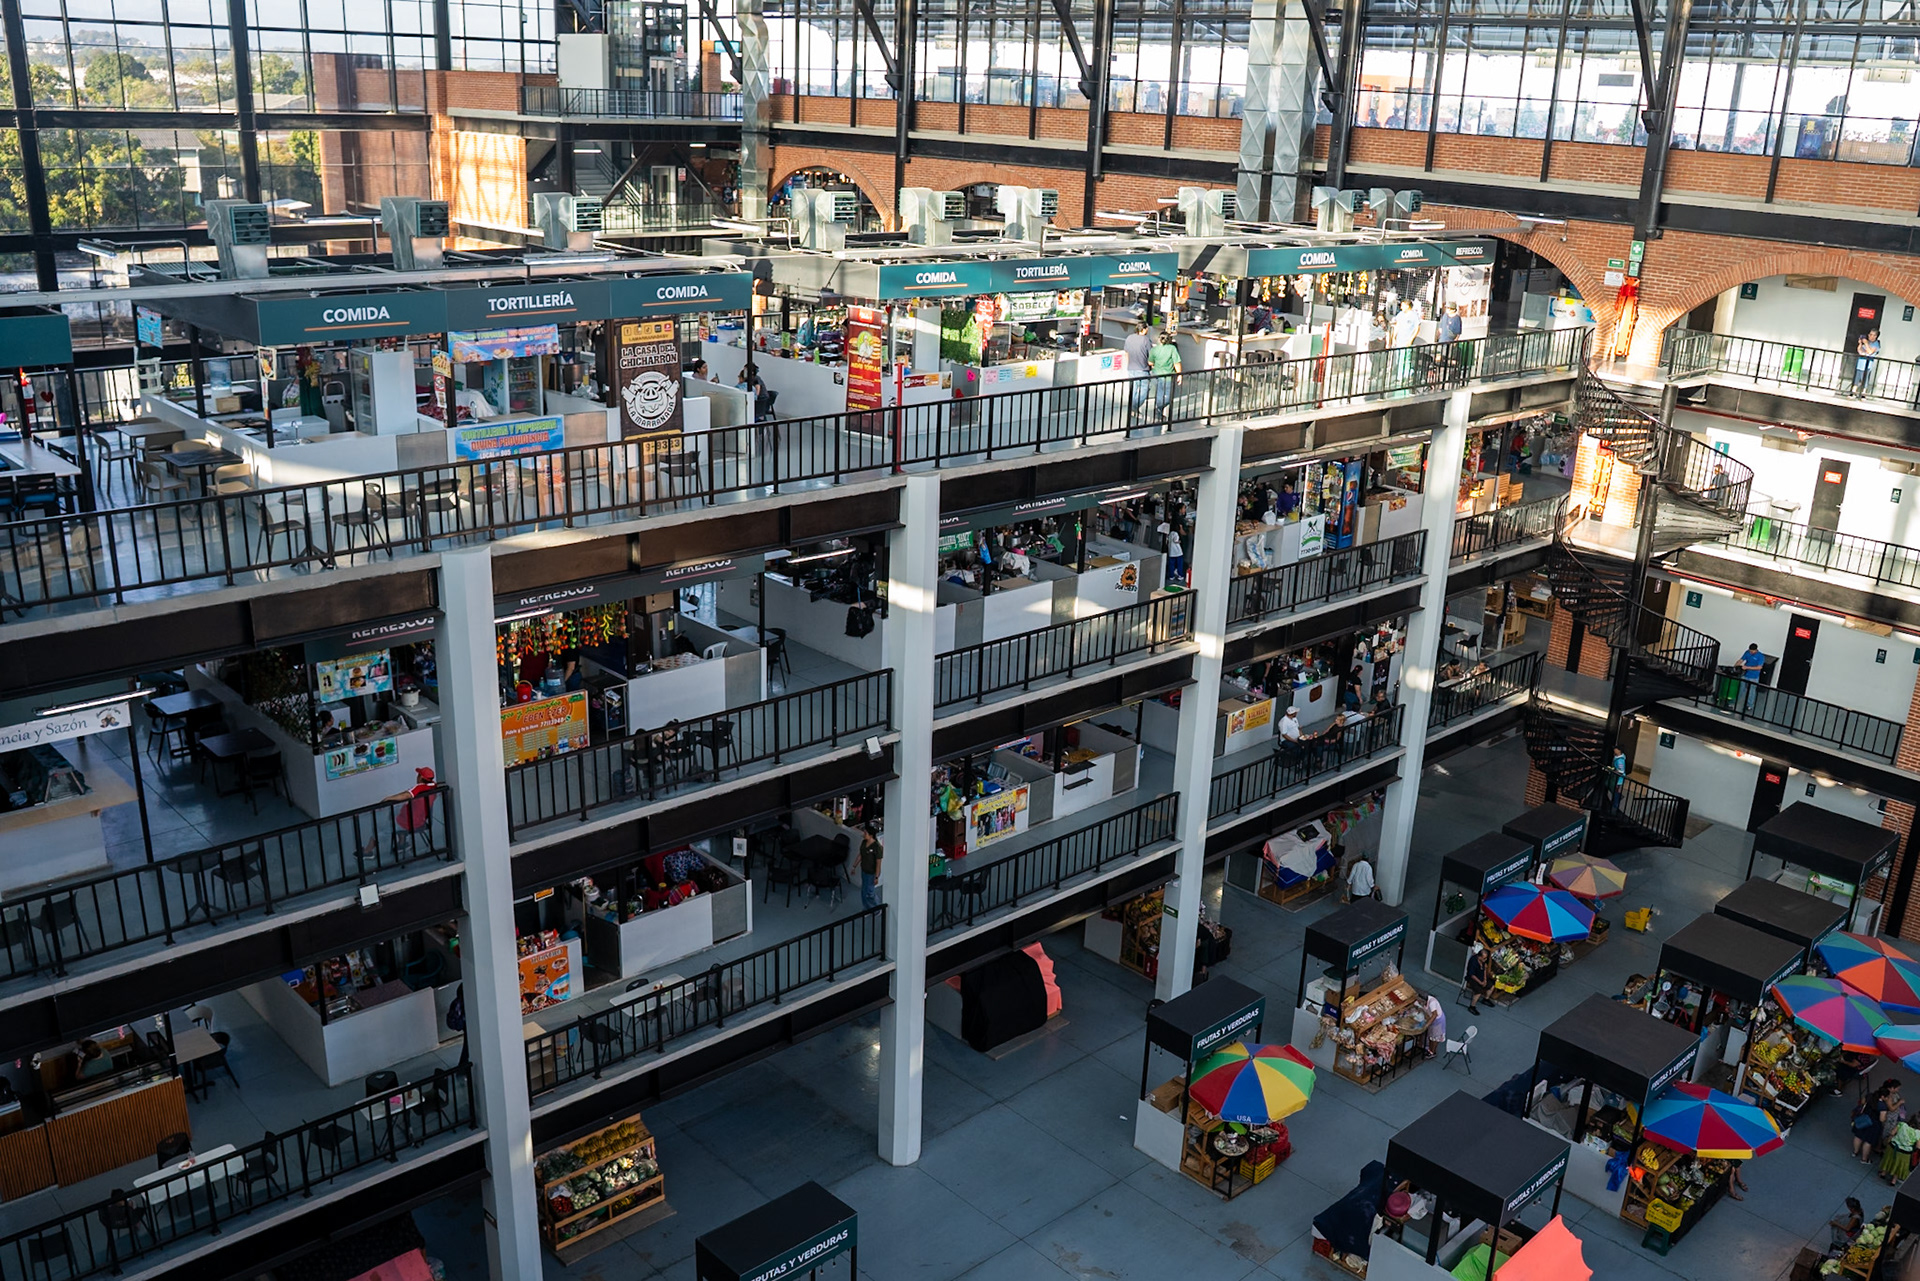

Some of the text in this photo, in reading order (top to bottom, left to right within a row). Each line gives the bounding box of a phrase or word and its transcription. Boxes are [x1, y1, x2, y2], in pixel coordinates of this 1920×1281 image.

[1300, 252, 1336, 265] COMIDA
[1401, 249, 1424, 258] COMIDA
[1456, 247, 1484, 255] REFRESCOS
[1016, 263, 1068, 278] TORTILLERÍA
[1119, 261, 1151, 272] COMIDA
[916, 272, 957, 284] COMIDA
[488, 290, 574, 311] TORTILLERÍA
[657, 285, 708, 299] COMIDA
[322, 305, 391, 323] COMIDA
[622, 343, 675, 357] LA CASA DEL
[628, 401, 675, 427] LA MARRANADA
[471, 431, 549, 451] DIVINA PROVIDENCIA
[0, 718, 87, 745] ncia y Sazón
[1486, 870, 1503, 883] FRUTAS
[1352, 942, 1372, 958] FRUTAS
[1377, 924, 1403, 944] VERDURAS
[1196, 1029, 1221, 1049] FRUTAS
[1227, 1008, 1259, 1031] VERDURAS
[1651, 1071, 1669, 1090] FRUTAS
[1673, 1048, 1696, 1072] VERDURAS
[1508, 1188, 1530, 1211] FRUTAS
[1536, 1158, 1565, 1187] VERDURAS
[751, 1229, 849, 1281] RUTAS Y VERDURAS
